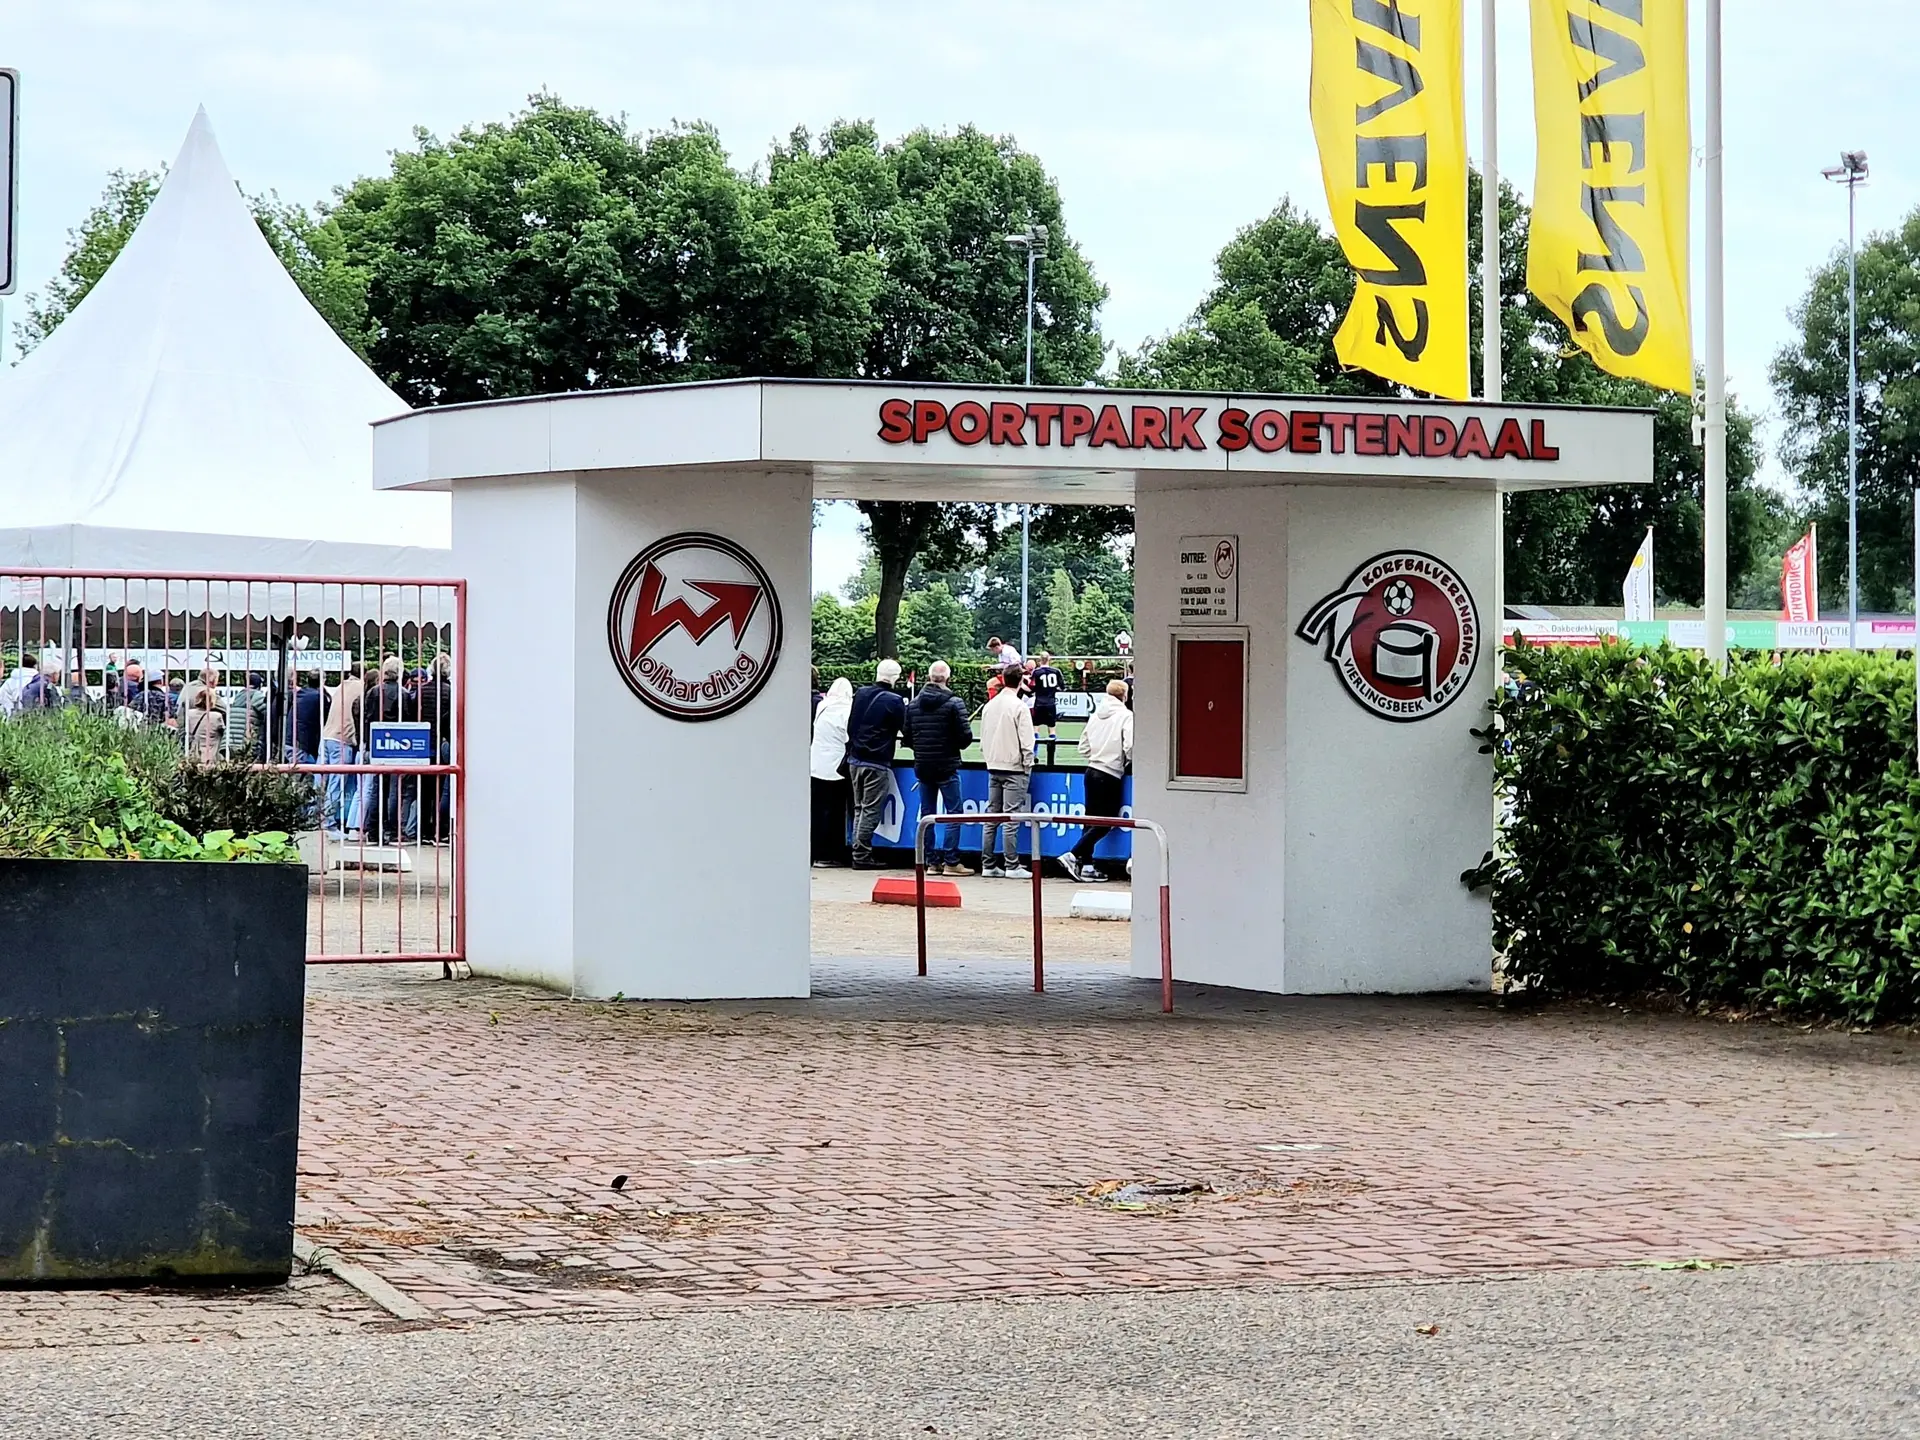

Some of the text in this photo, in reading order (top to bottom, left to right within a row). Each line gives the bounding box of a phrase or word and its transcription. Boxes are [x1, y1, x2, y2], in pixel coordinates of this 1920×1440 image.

[878, 399, 1559, 461] SPORTPARK SOETENDAAL
[1361, 558, 1474, 666] KORFBALVERENIGING
[1040, 673, 1057, 688] 10
[1343, 658, 1462, 713] VIERLINGSBEEK D.E.S.
